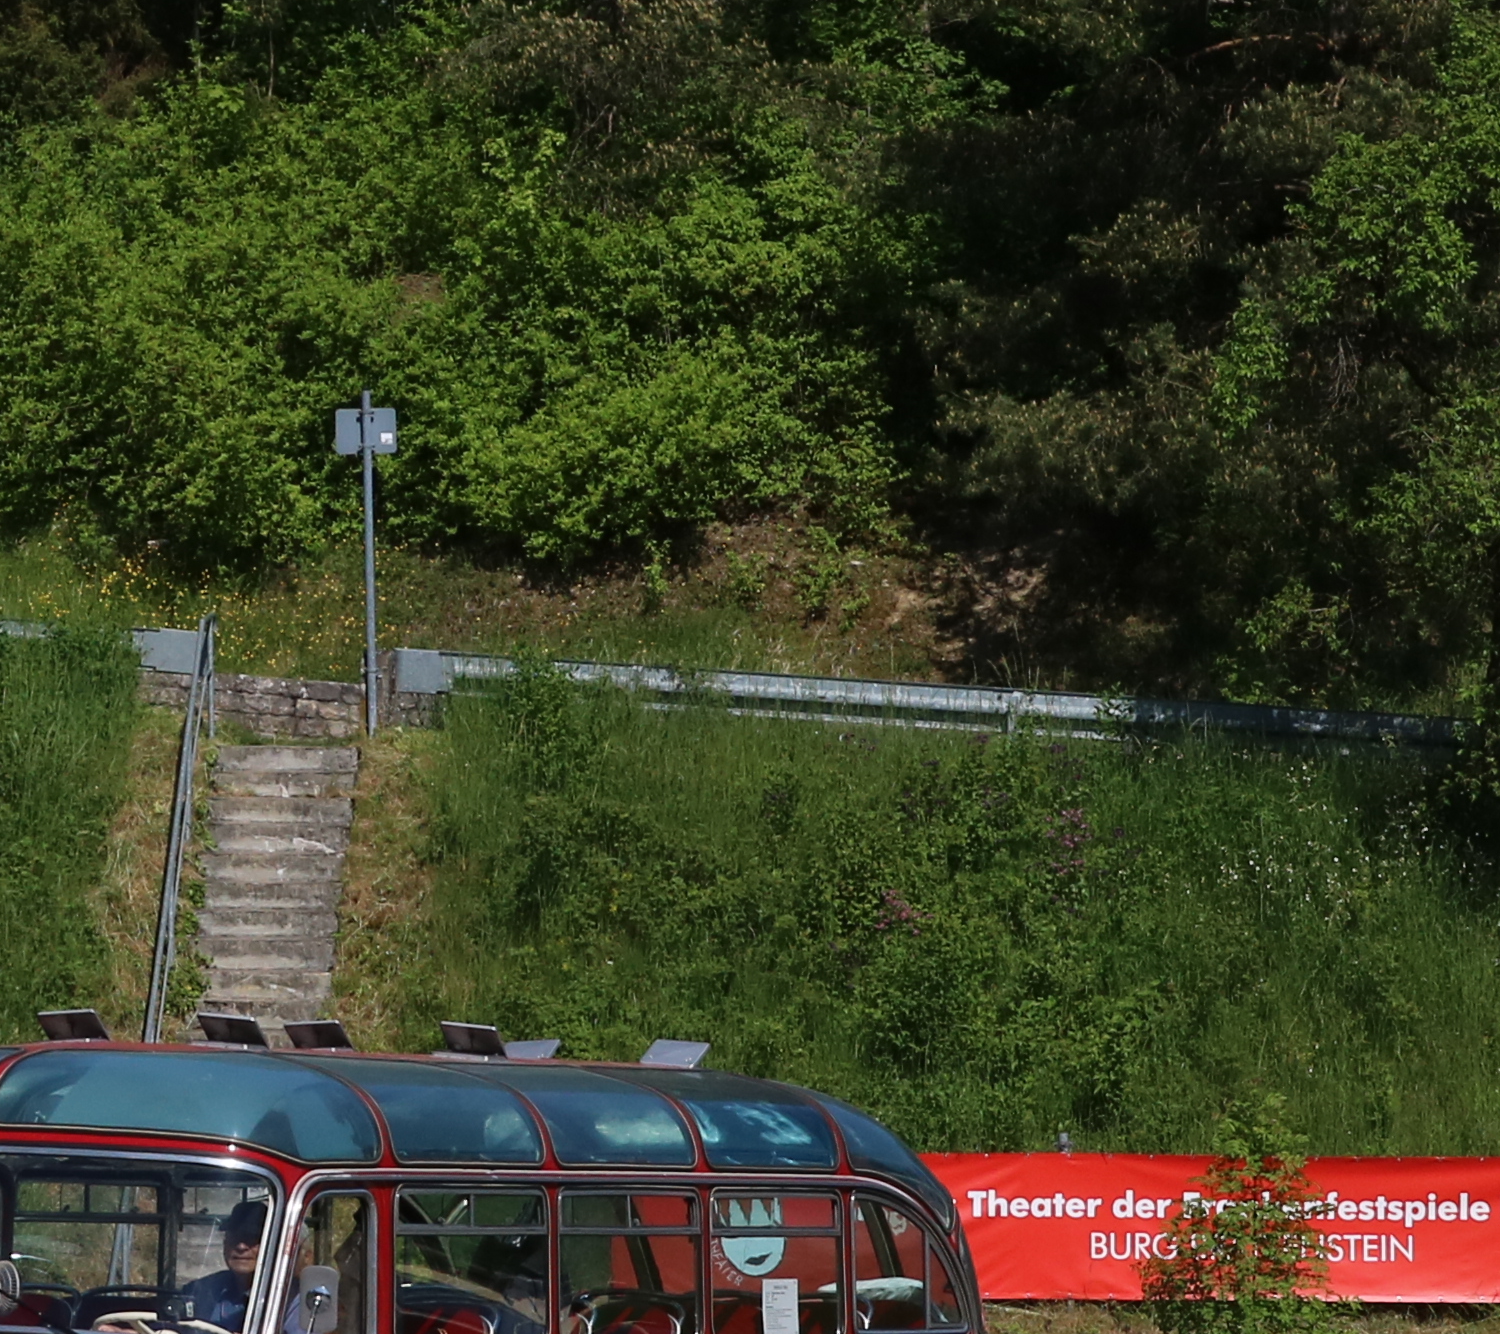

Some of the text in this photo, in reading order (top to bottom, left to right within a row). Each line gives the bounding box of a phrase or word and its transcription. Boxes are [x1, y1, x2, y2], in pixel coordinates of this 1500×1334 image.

[966, 1189, 1103, 1219] Theater
[1112, 1189, 1173, 1219] der
[1090, 1231, 1179, 1261] BURG
